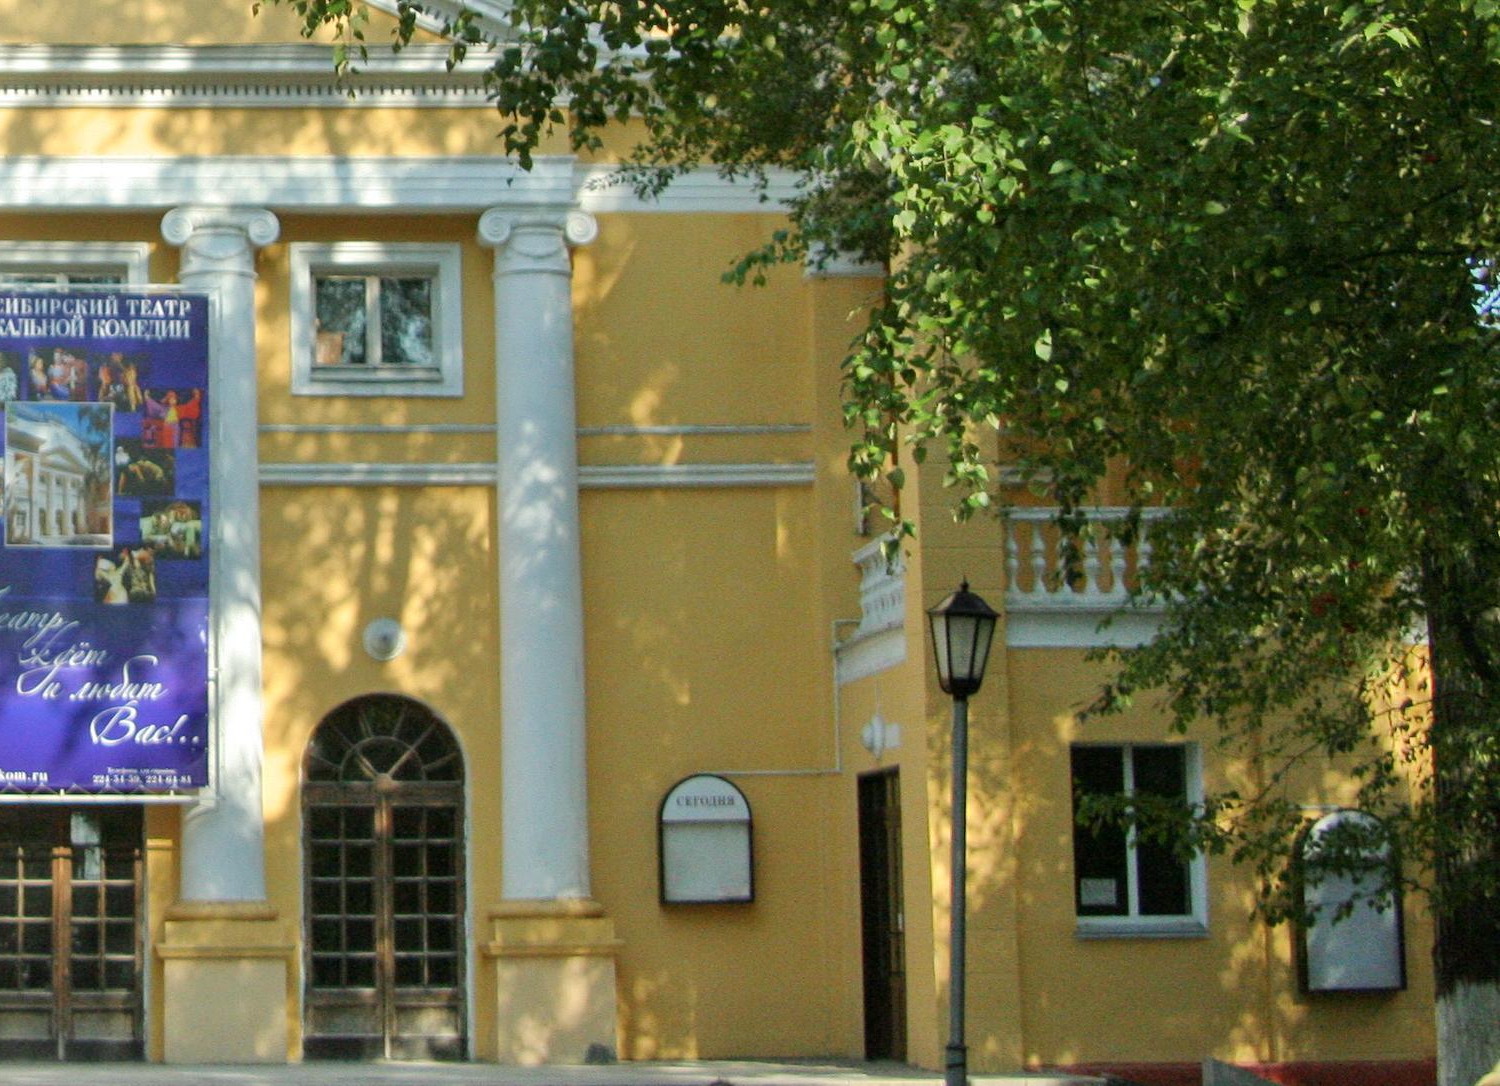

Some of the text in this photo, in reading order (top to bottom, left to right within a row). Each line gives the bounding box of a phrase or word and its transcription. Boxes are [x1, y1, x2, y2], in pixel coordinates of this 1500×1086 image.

[126, 297, 191, 317] ТЕАТР
[92, 318, 191, 340] КОМЕДИИ
[69, 654, 169, 701] любит
[676, 795, 735, 807] СЕГОДНЯ
